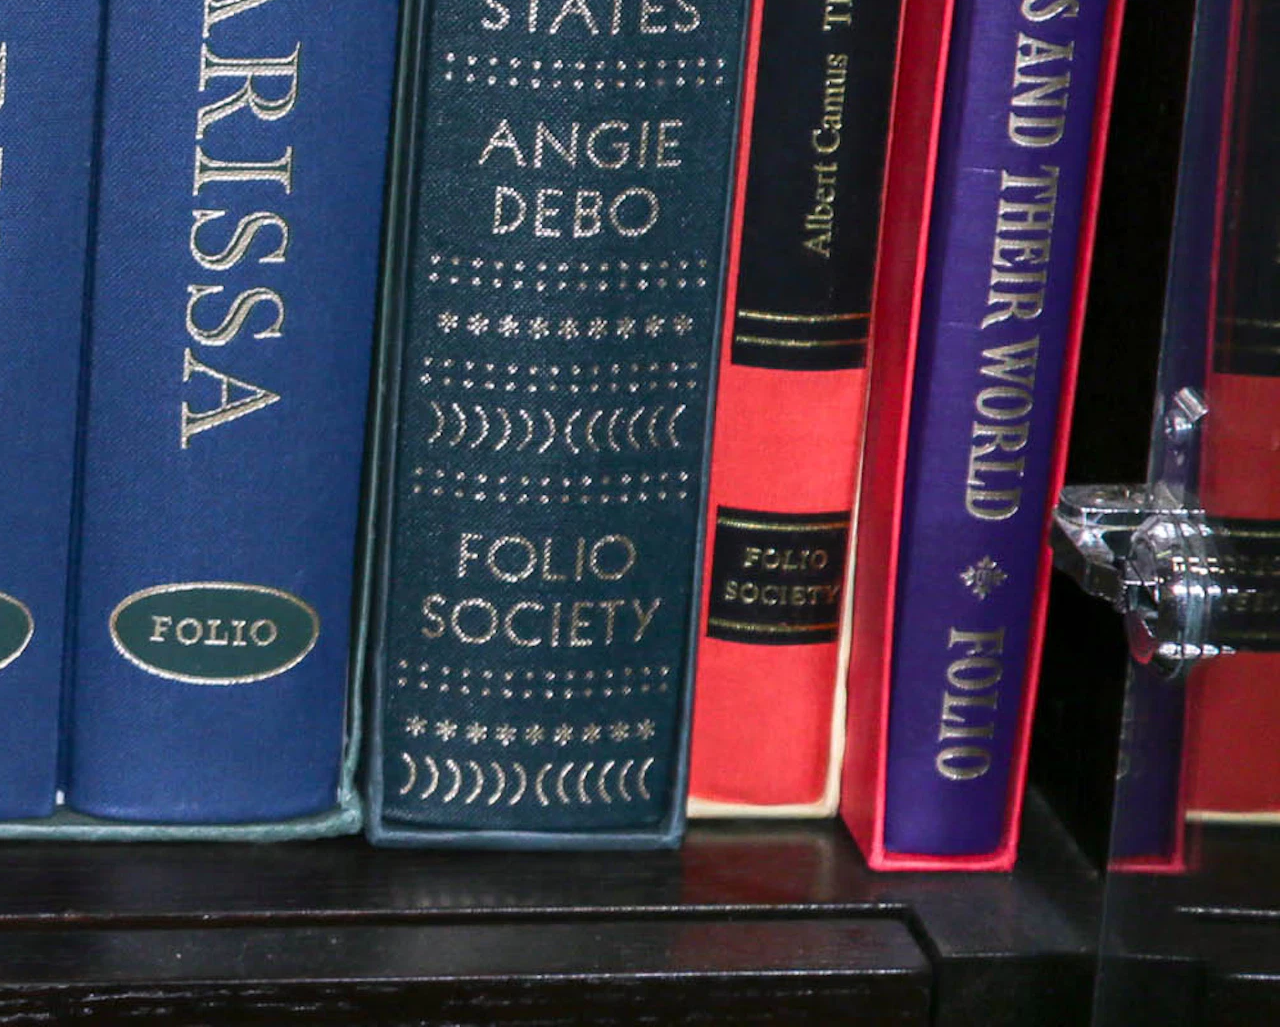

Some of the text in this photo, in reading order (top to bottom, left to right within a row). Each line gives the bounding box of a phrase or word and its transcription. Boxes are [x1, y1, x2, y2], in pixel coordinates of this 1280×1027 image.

[811, 52, 849, 156] Camus
[1007, 31, 1075, 148] AND
[477, 118, 684, 170] ANGIE
[491, 185, 660, 238] DEBO
[802, 161, 839, 257] Albert
[981, 165, 1059, 330] THEIR
[965, 334, 1040, 520] WORLD
[456, 532, 637, 583] FOLIO
[744, 547, 829, 570] FOLIO
[421, 593, 661, 648] SOCIETY
[725, 580, 840, 606] SOCIETY
[150, 615, 277, 646] FOLIO
[936, 625, 1006, 780] FOLIO
